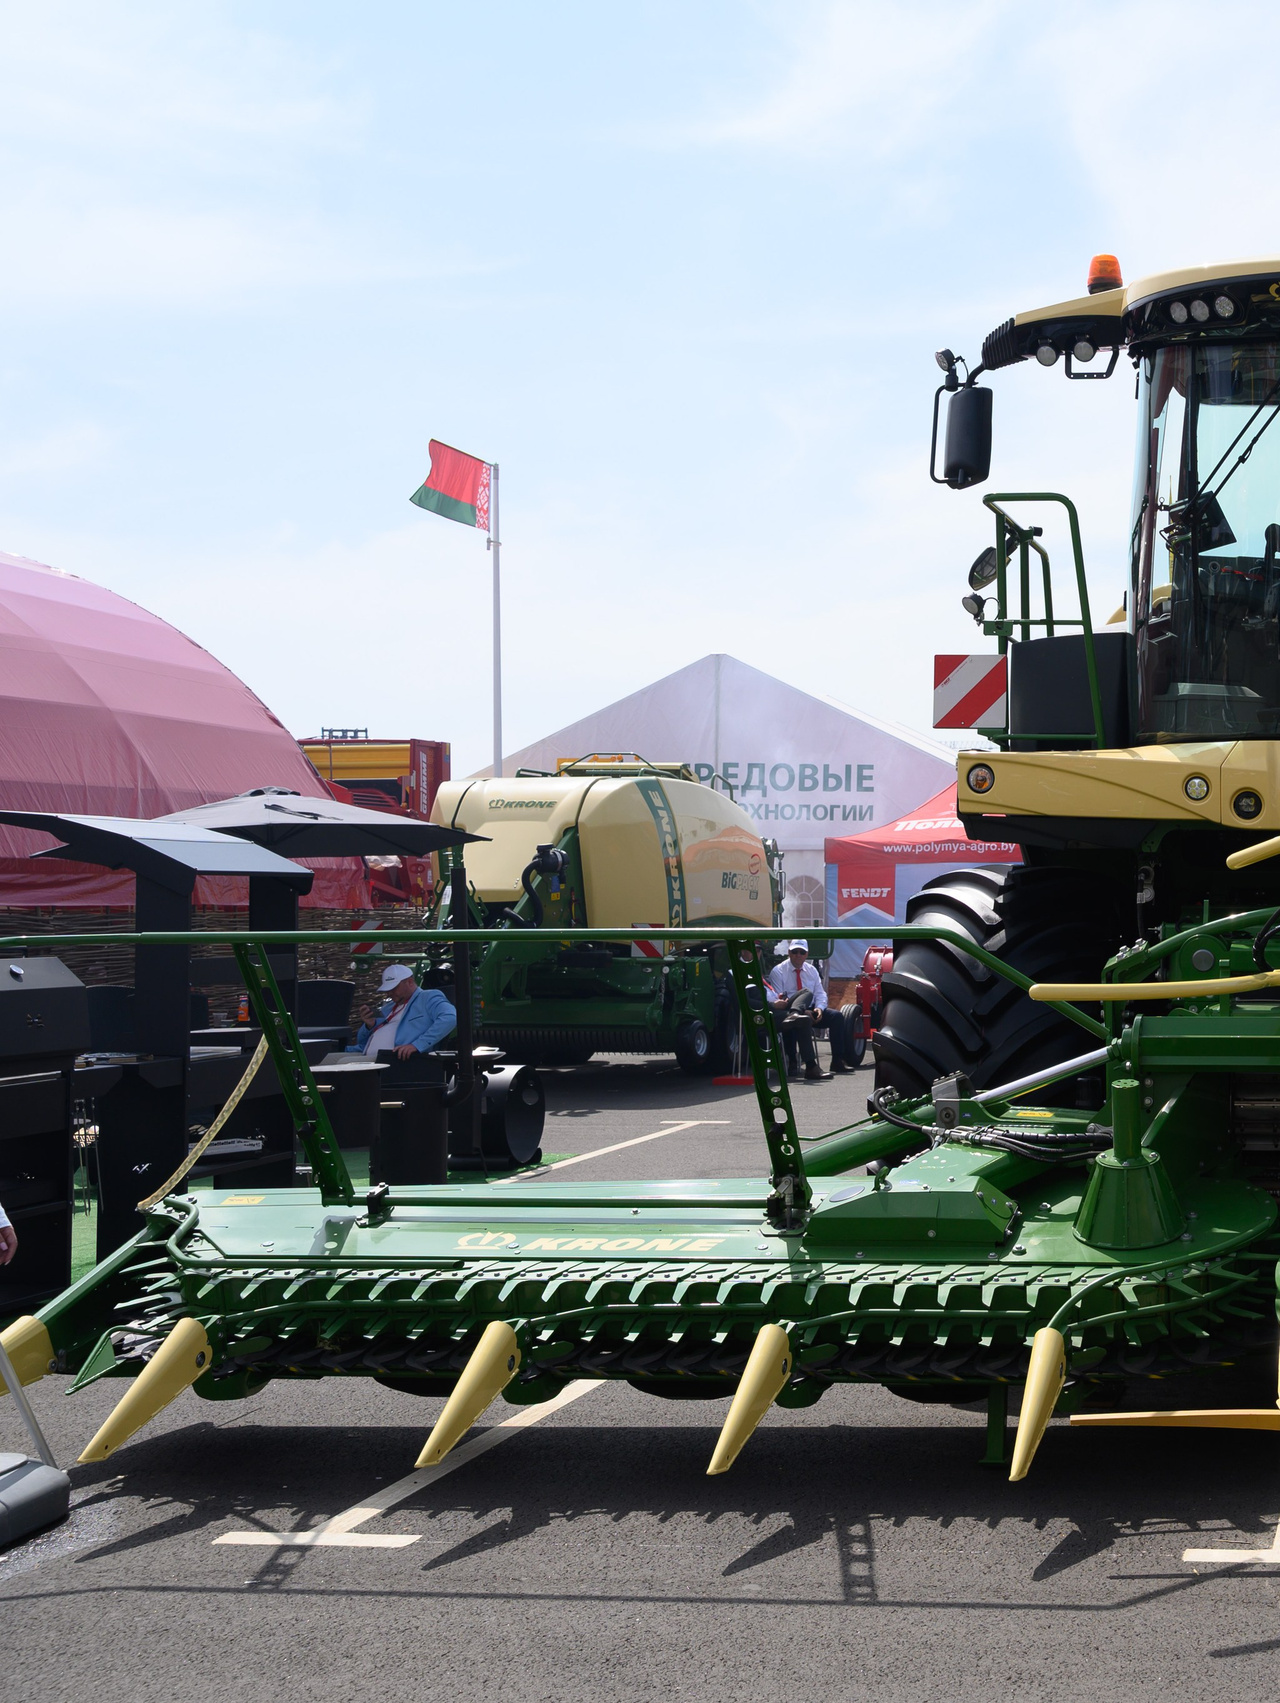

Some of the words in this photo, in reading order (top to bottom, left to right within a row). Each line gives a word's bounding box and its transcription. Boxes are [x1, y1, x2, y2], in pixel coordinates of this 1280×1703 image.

[689, 763, 875, 797] РЕДОВЫЕ
[503, 800, 558, 809] KRONE
[649, 789, 682, 900] KRONE
[883, 842, 1016, 854] www.polymya-agro.by
[841, 887, 891, 898] FENDT
[521, 1238, 726, 1251] KRONE
